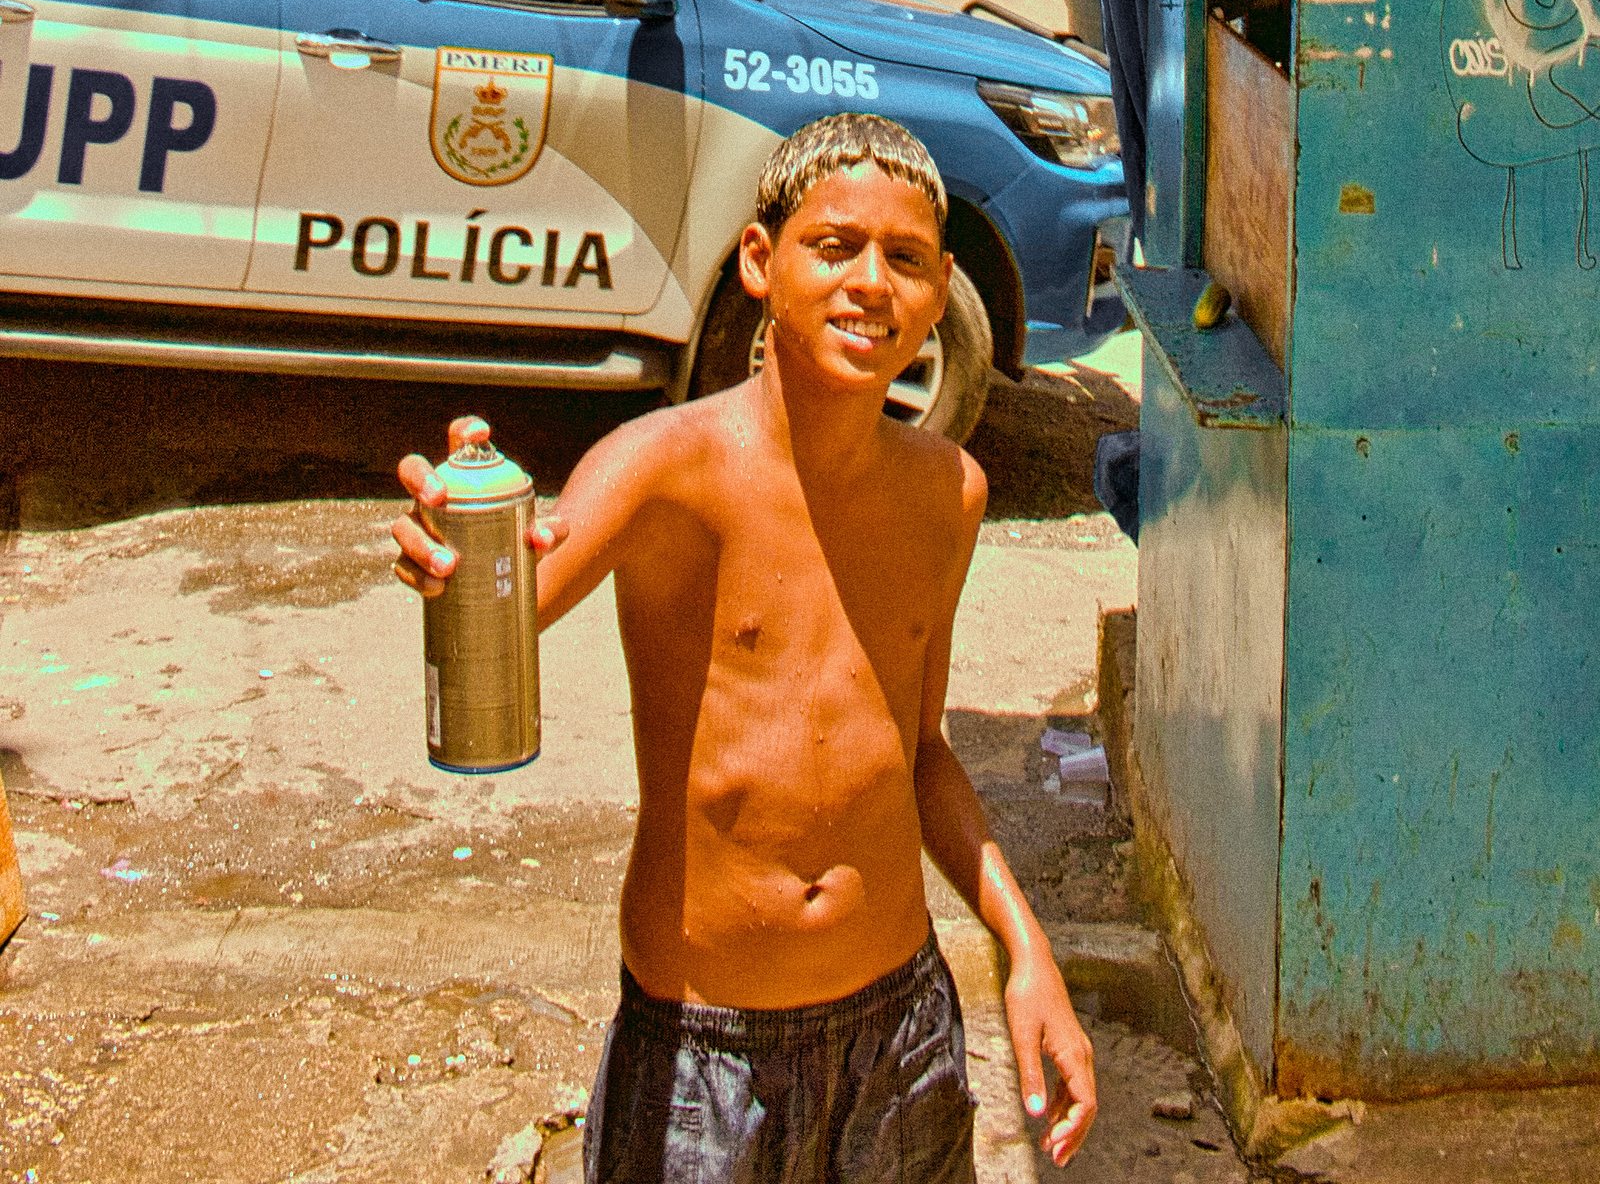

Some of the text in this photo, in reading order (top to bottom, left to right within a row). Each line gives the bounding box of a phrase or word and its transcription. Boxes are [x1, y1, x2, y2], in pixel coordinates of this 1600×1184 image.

[446, 52, 542, 73] PMERJ
[723, 47, 879, 100] 52-3055
[293, 208, 613, 290] POLÍCIA
